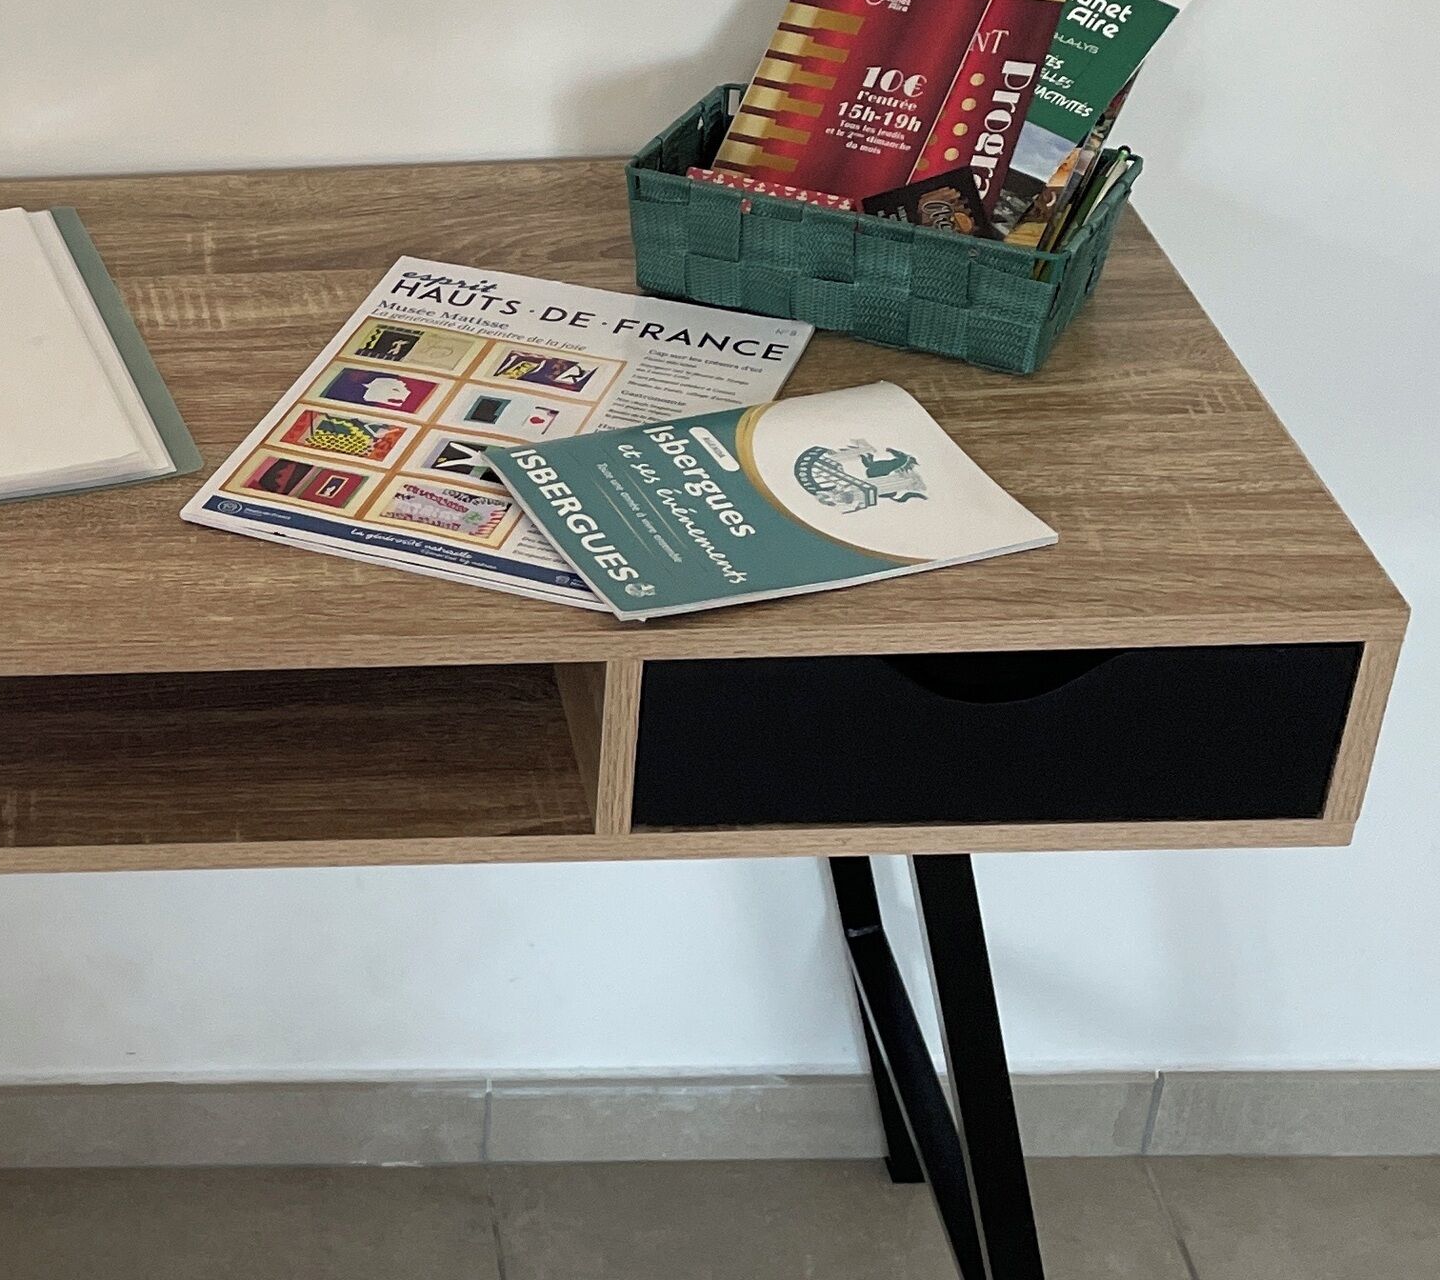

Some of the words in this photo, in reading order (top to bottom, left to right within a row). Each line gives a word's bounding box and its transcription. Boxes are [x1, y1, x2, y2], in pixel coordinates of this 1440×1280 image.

[1066, 6, 1119, 39] Aire
[862, 66, 927, 98] 10€
[838, 101, 922, 133] 15h-19h
[402, 270, 498, 293] esprit
[378, 300, 436, 317] Musée
[441, 311, 510, 330] Matisse
[391, 279, 521, 315] HAUTS
[539, 306, 597, 328] DE
[613, 318, 789, 361] FRANCE
[457, 324, 476, 334] du
[476, 328, 525, 342] peintre
[527, 336, 544, 345] de
[546, 338, 560, 347] la
[560, 342, 587, 352] joie
[617, 443, 644, 460] et
[630, 463, 661, 485] ses
[642, 425, 755, 538] Isbergues
[510, 448, 640, 583] ISBERGUES
[656, 488, 747, 585] événements
